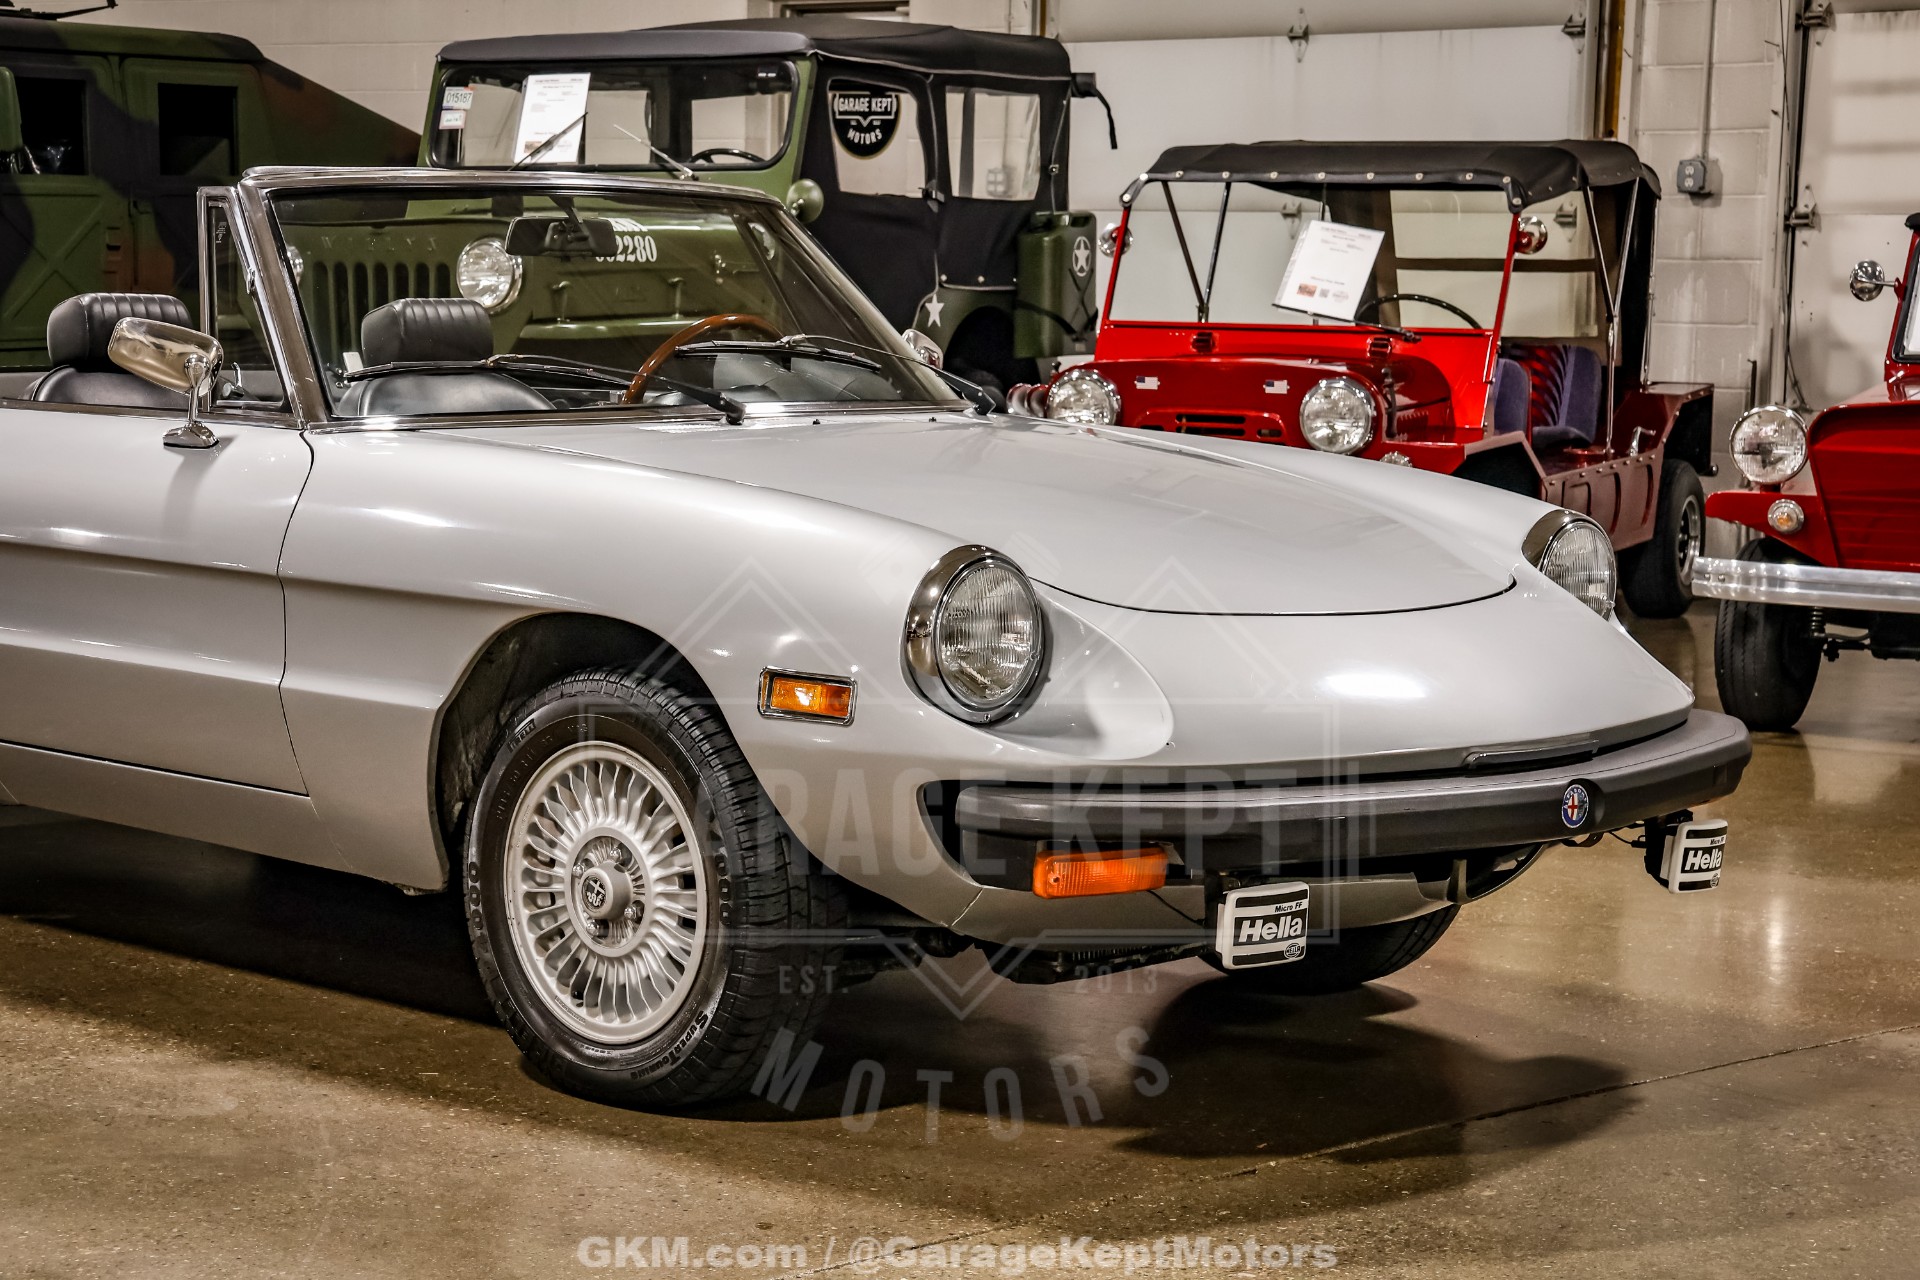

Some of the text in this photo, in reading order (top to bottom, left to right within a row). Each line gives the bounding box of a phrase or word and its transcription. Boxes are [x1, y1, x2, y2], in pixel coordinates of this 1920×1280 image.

[446, 92, 472, 104] 015187
[838, 97, 892, 112] GARAGE KEPT
[847, 128, 882, 144] MOTORS
[595, 235, 658, 263] 2280
[1684, 848, 1723, 871] Hella
[1274, 901, 1303, 913] Micro FF
[1238, 915, 1303, 943] Hella
